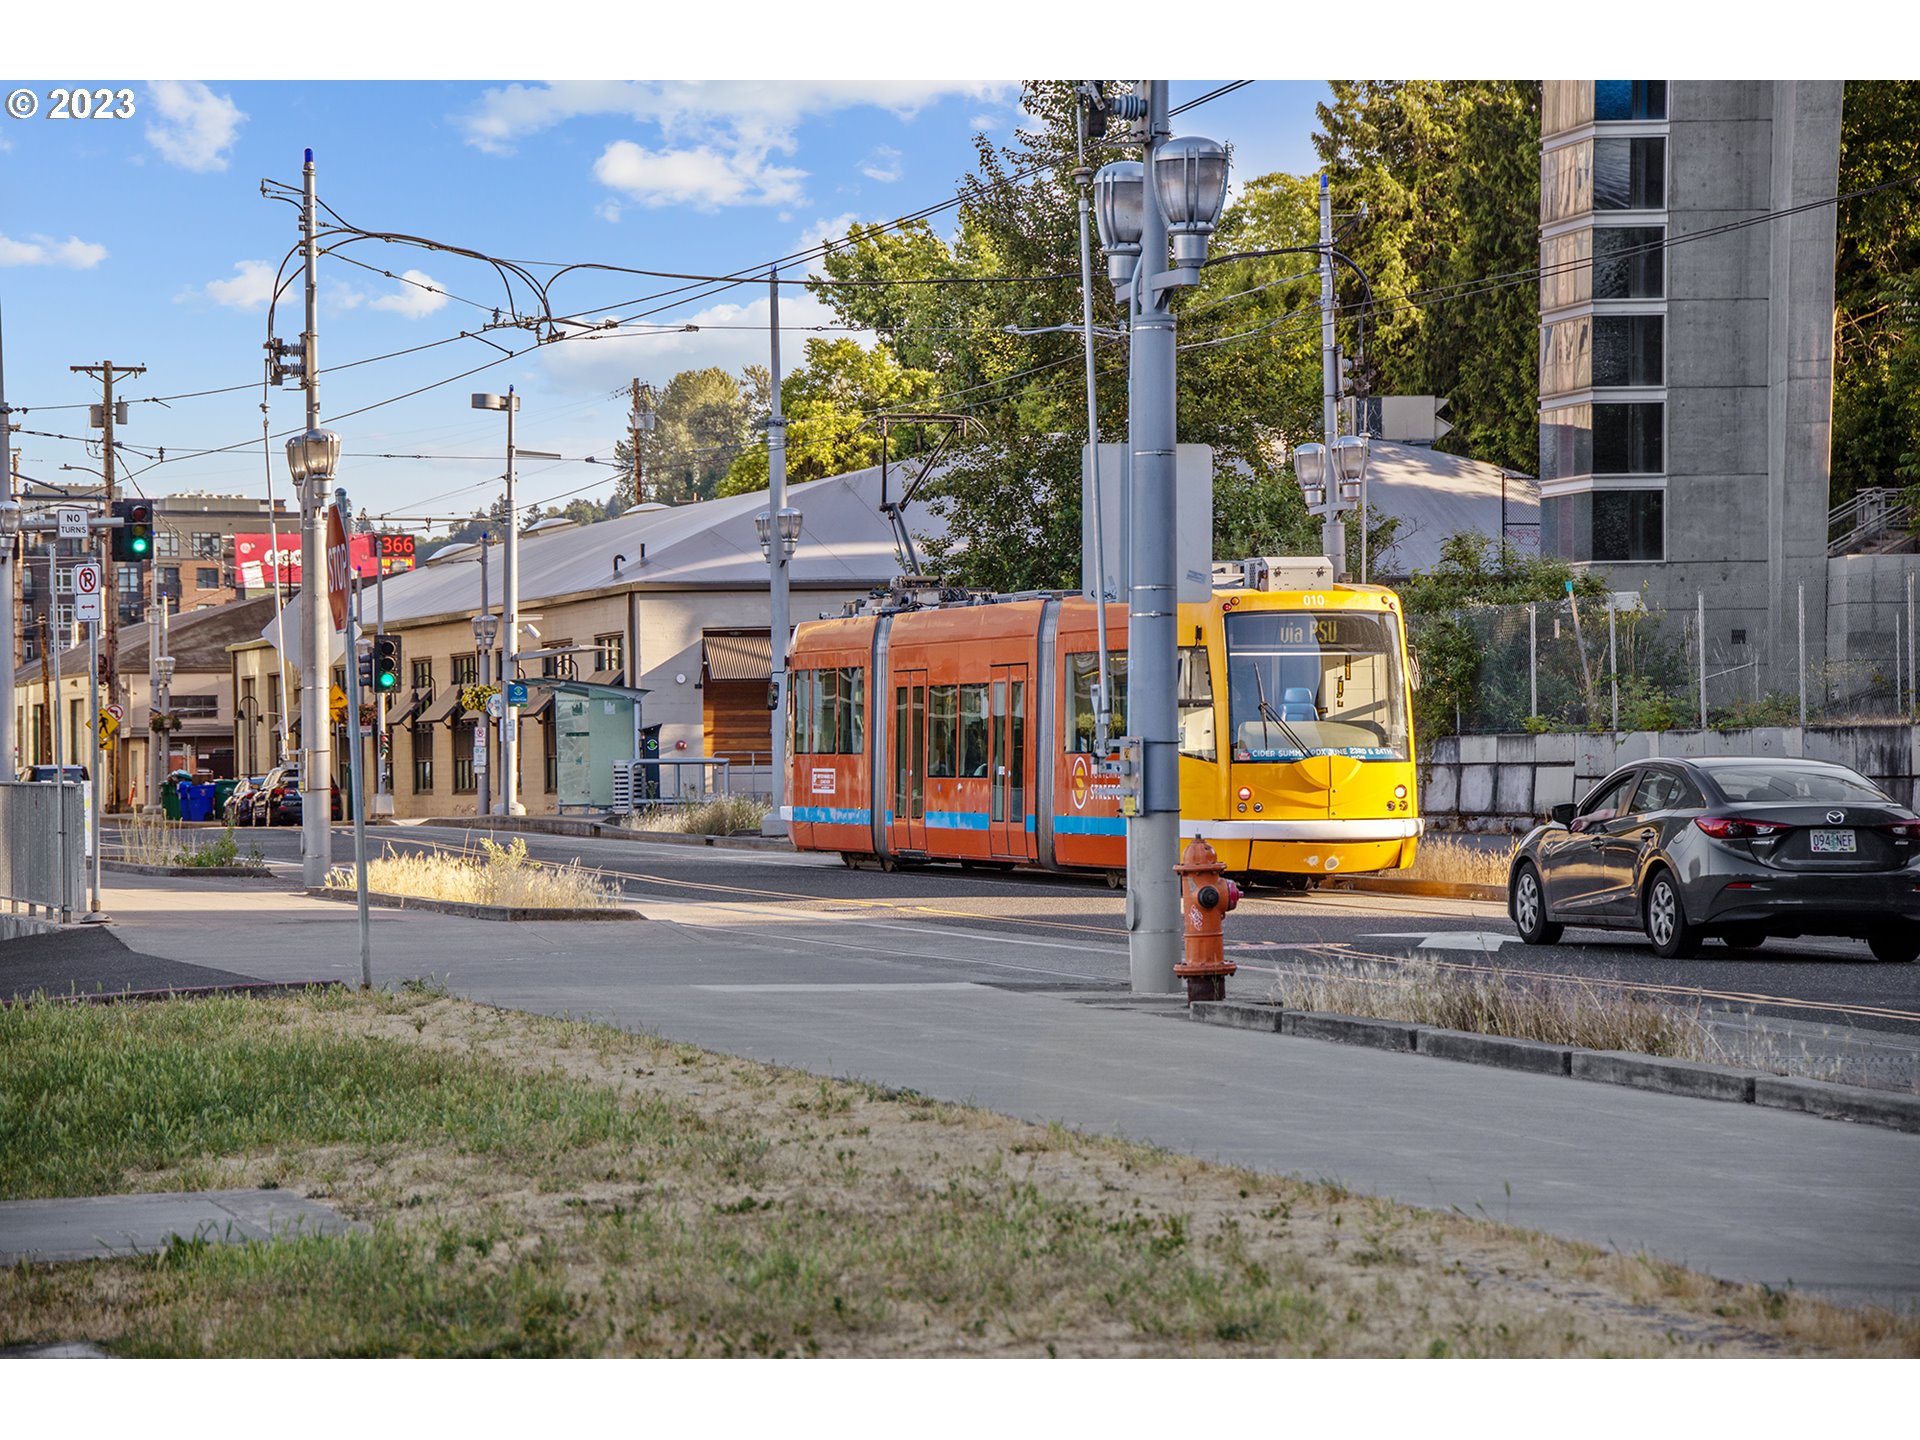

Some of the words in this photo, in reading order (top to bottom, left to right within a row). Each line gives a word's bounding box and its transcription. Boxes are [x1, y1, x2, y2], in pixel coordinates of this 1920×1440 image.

[66, 514, 81, 523] NO
[60, 526, 87, 534] TURNS
[381, 536, 414, 553] 366
[328, 543, 347, 593] STOP
[1303, 594, 1325, 607] 010
[1280, 622, 1304, 644] via
[1309, 620, 1337, 643] PSU
[1252, 749, 1276, 758] CIDER
[1813, 834, 1831, 847] 094
[1836, 834, 1853, 847] NEF
